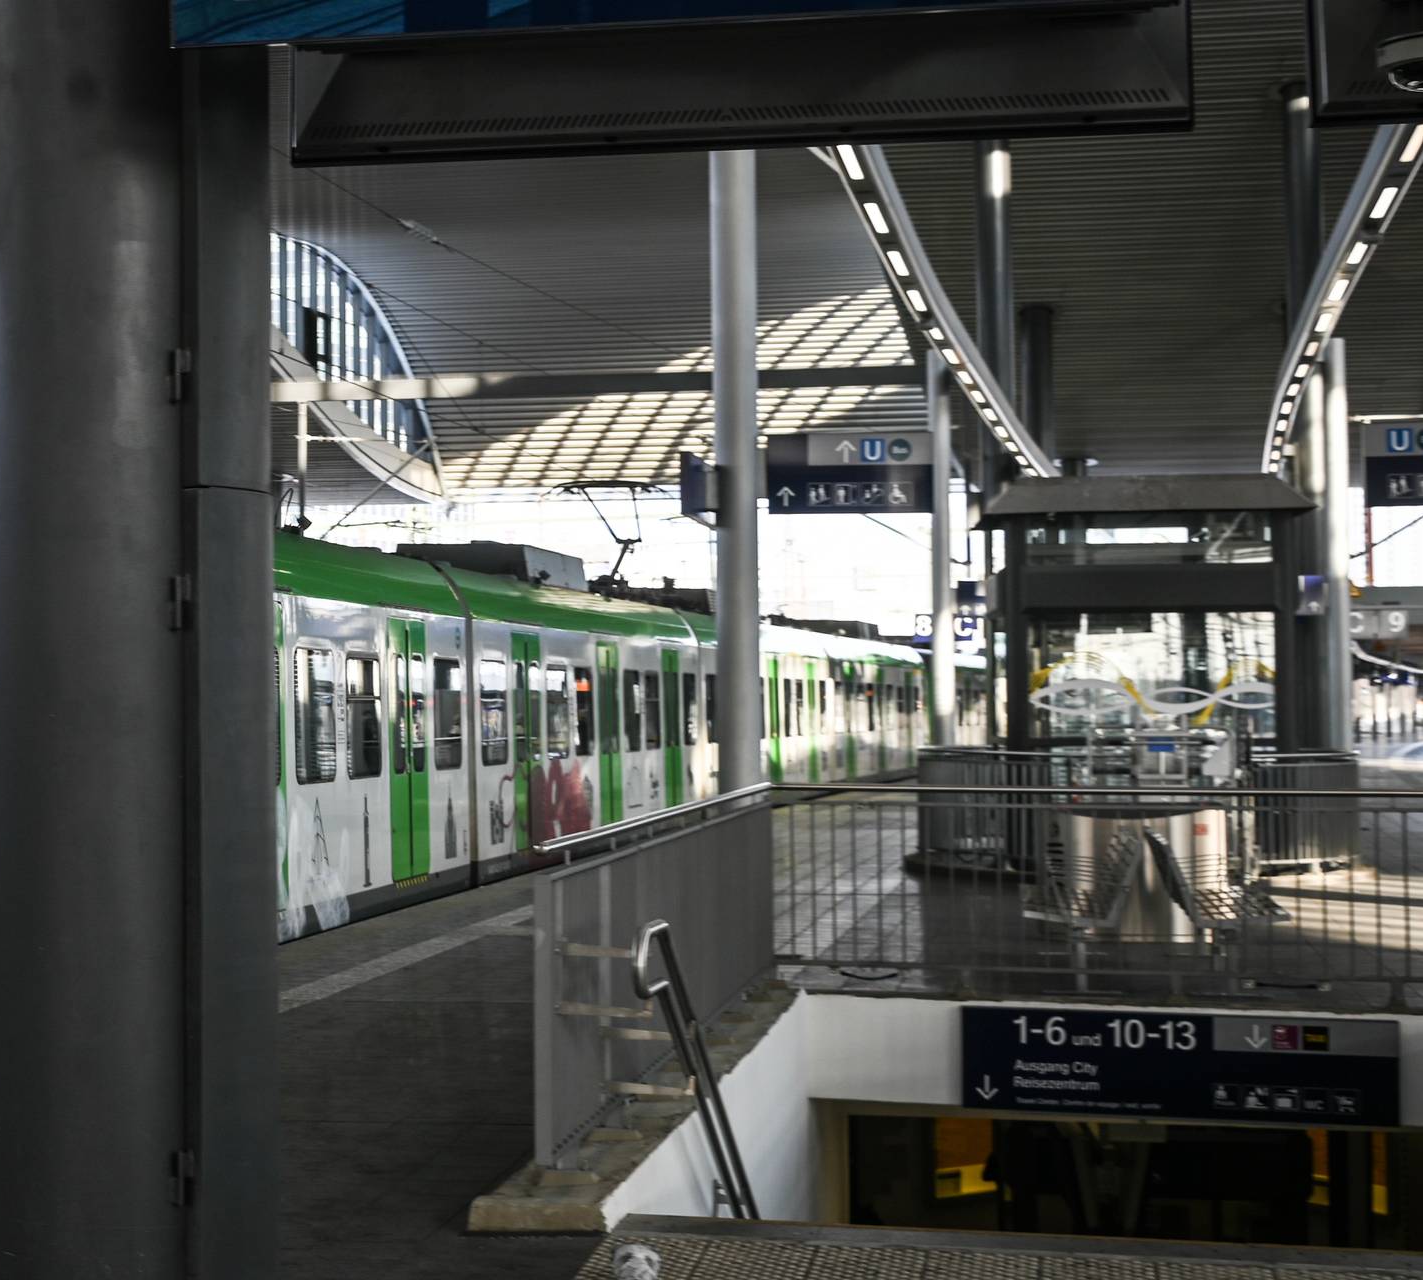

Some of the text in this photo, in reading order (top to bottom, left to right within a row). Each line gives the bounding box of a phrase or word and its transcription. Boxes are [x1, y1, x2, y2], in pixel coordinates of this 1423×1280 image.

[864, 440, 881, 461] U
[1389, 429, 1410, 451] U
[915, 614, 933, 637] 8
[1388, 611, 1406, 633] 9
[1012, 1015, 1197, 1050] 1-6 und 10-13
[1013, 1059, 1099, 1076] Ausgang City
[1013, 1076, 1101, 1091] Reisezentrum
